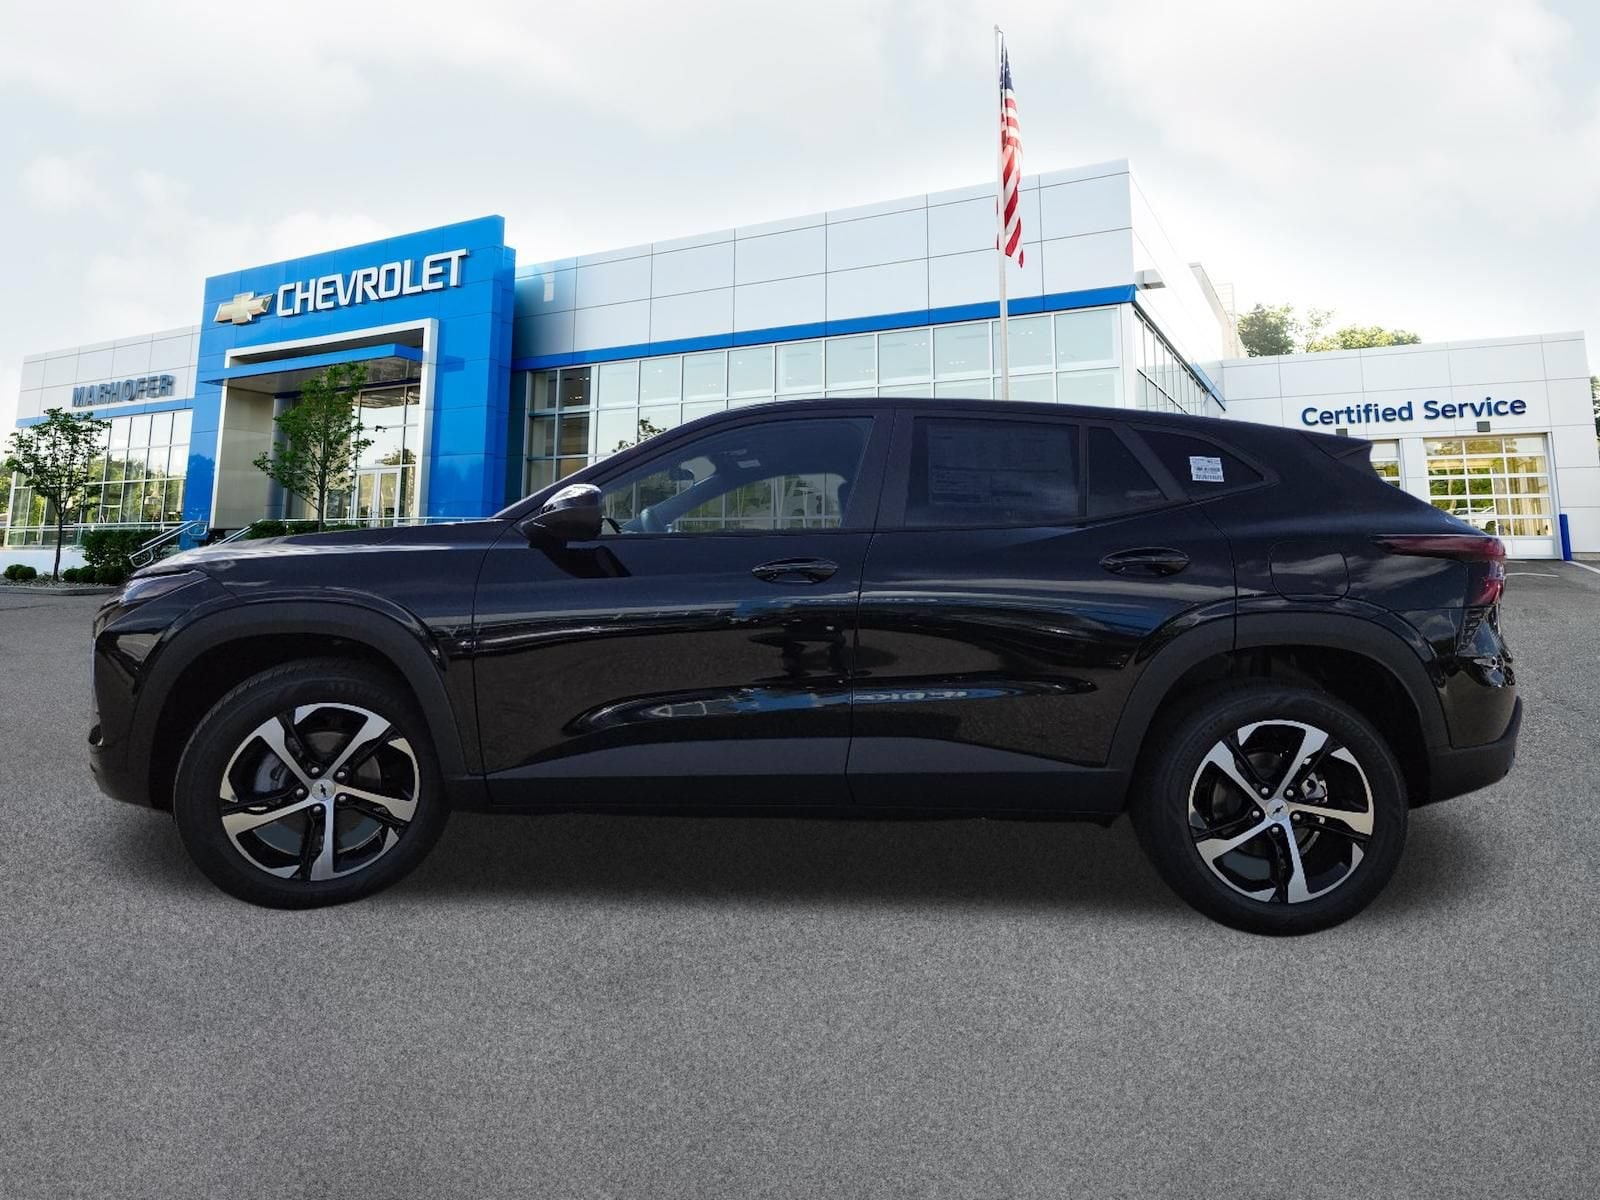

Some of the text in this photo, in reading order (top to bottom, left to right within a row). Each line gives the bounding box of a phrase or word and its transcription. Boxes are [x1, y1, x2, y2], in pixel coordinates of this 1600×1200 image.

[276, 248, 469, 317] CHEVROLET
[72, 375, 174, 407] MARHOFER
[1301, 396, 1527, 426] Certified Service
